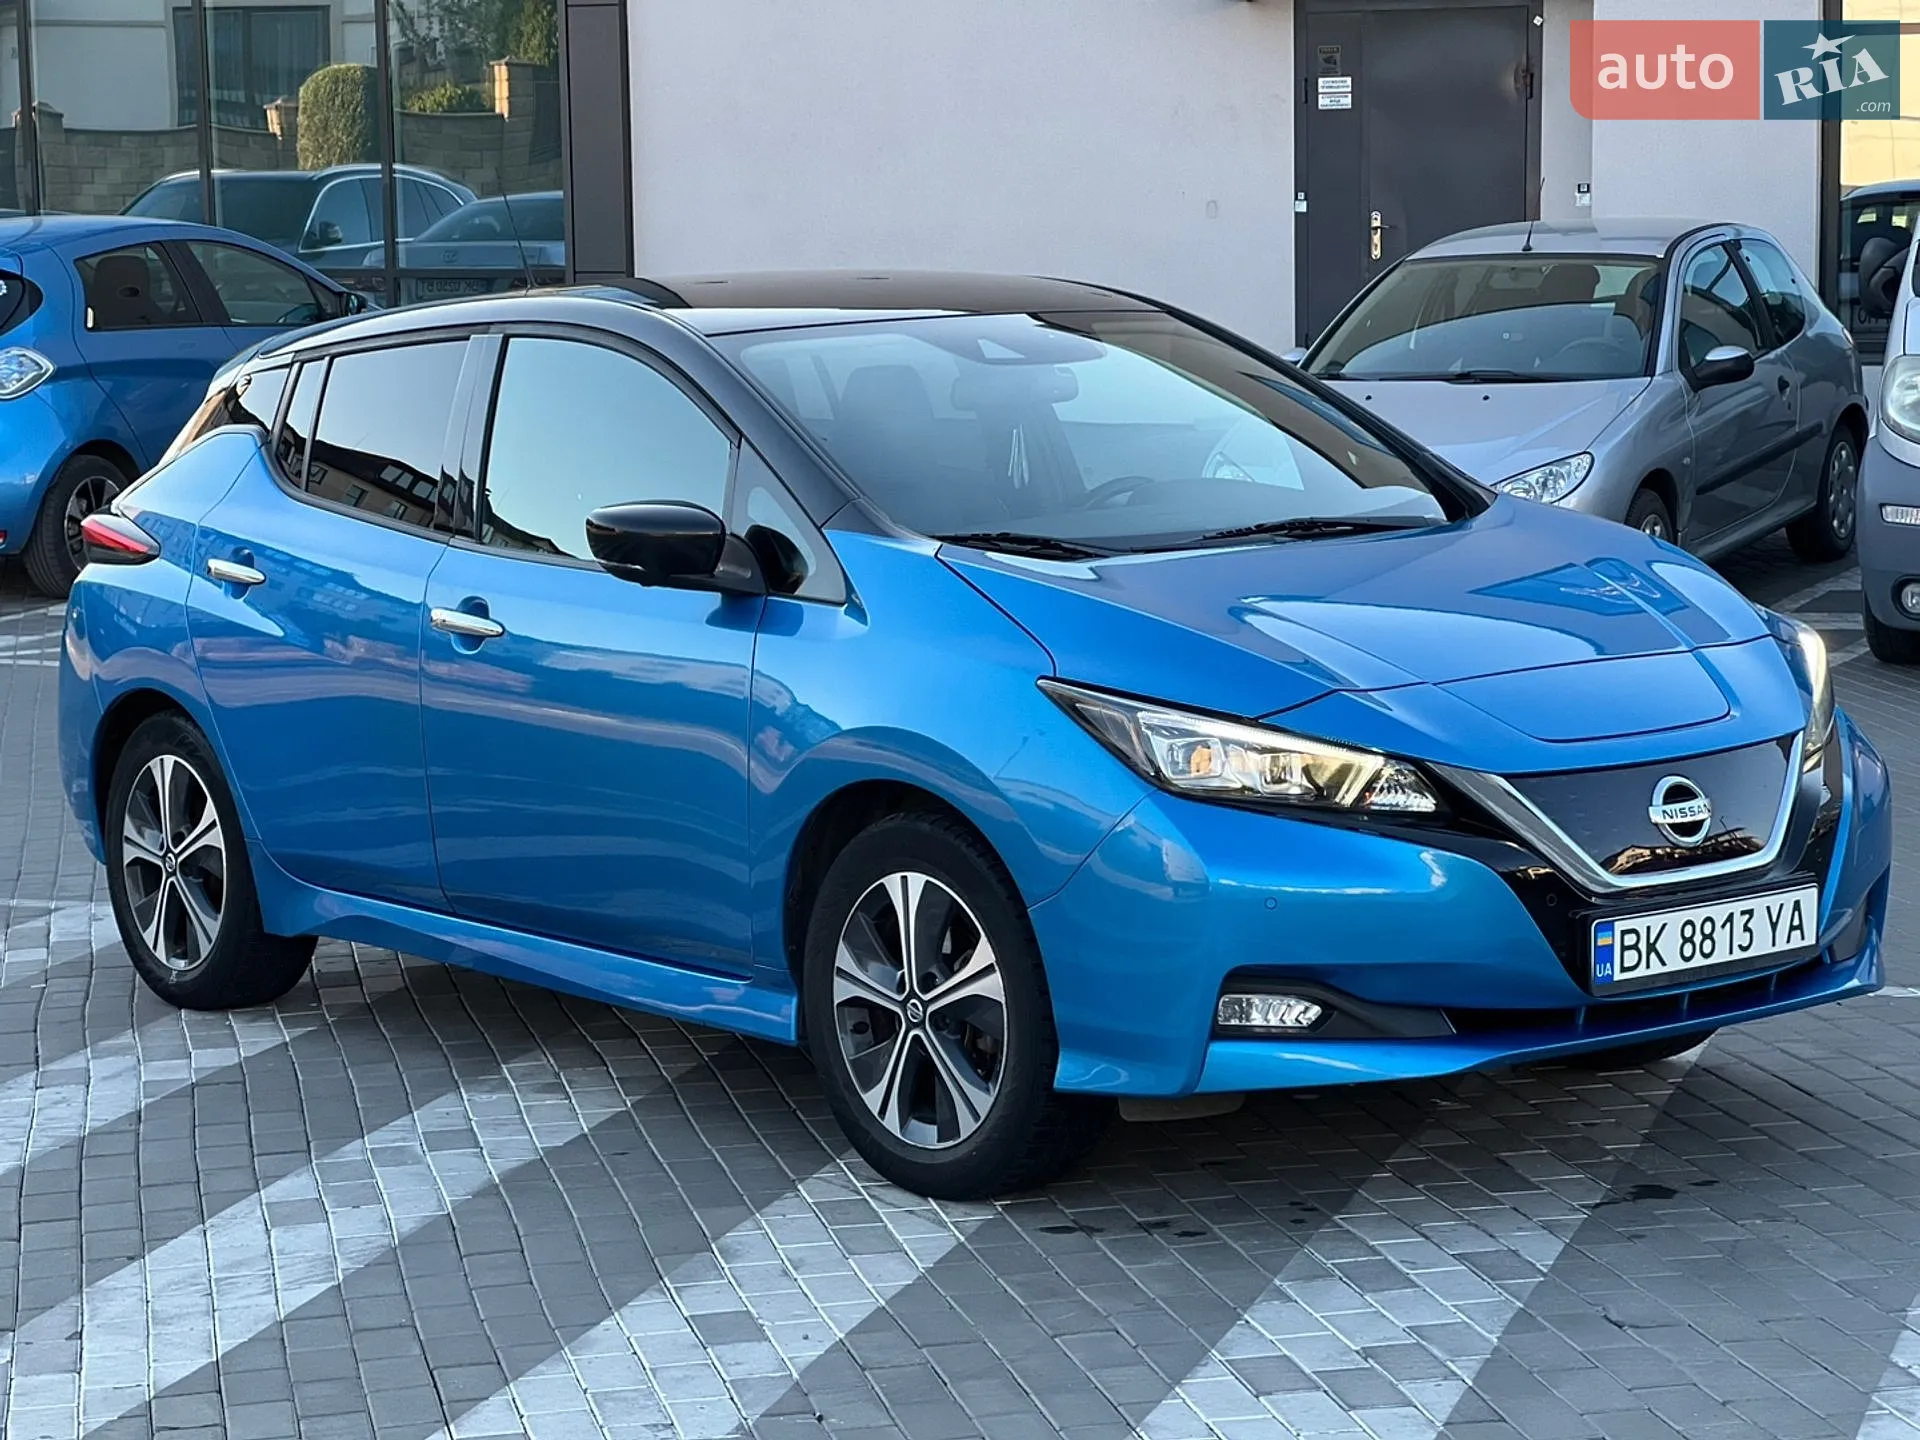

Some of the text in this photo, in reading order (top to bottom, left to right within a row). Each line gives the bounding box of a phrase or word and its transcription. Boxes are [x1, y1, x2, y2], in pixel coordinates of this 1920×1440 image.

[1662, 804, 1711, 820] NISSAN
[1619, 899, 1805, 973] BK 8813 YA
[1596, 963, 1612, 977] UA
